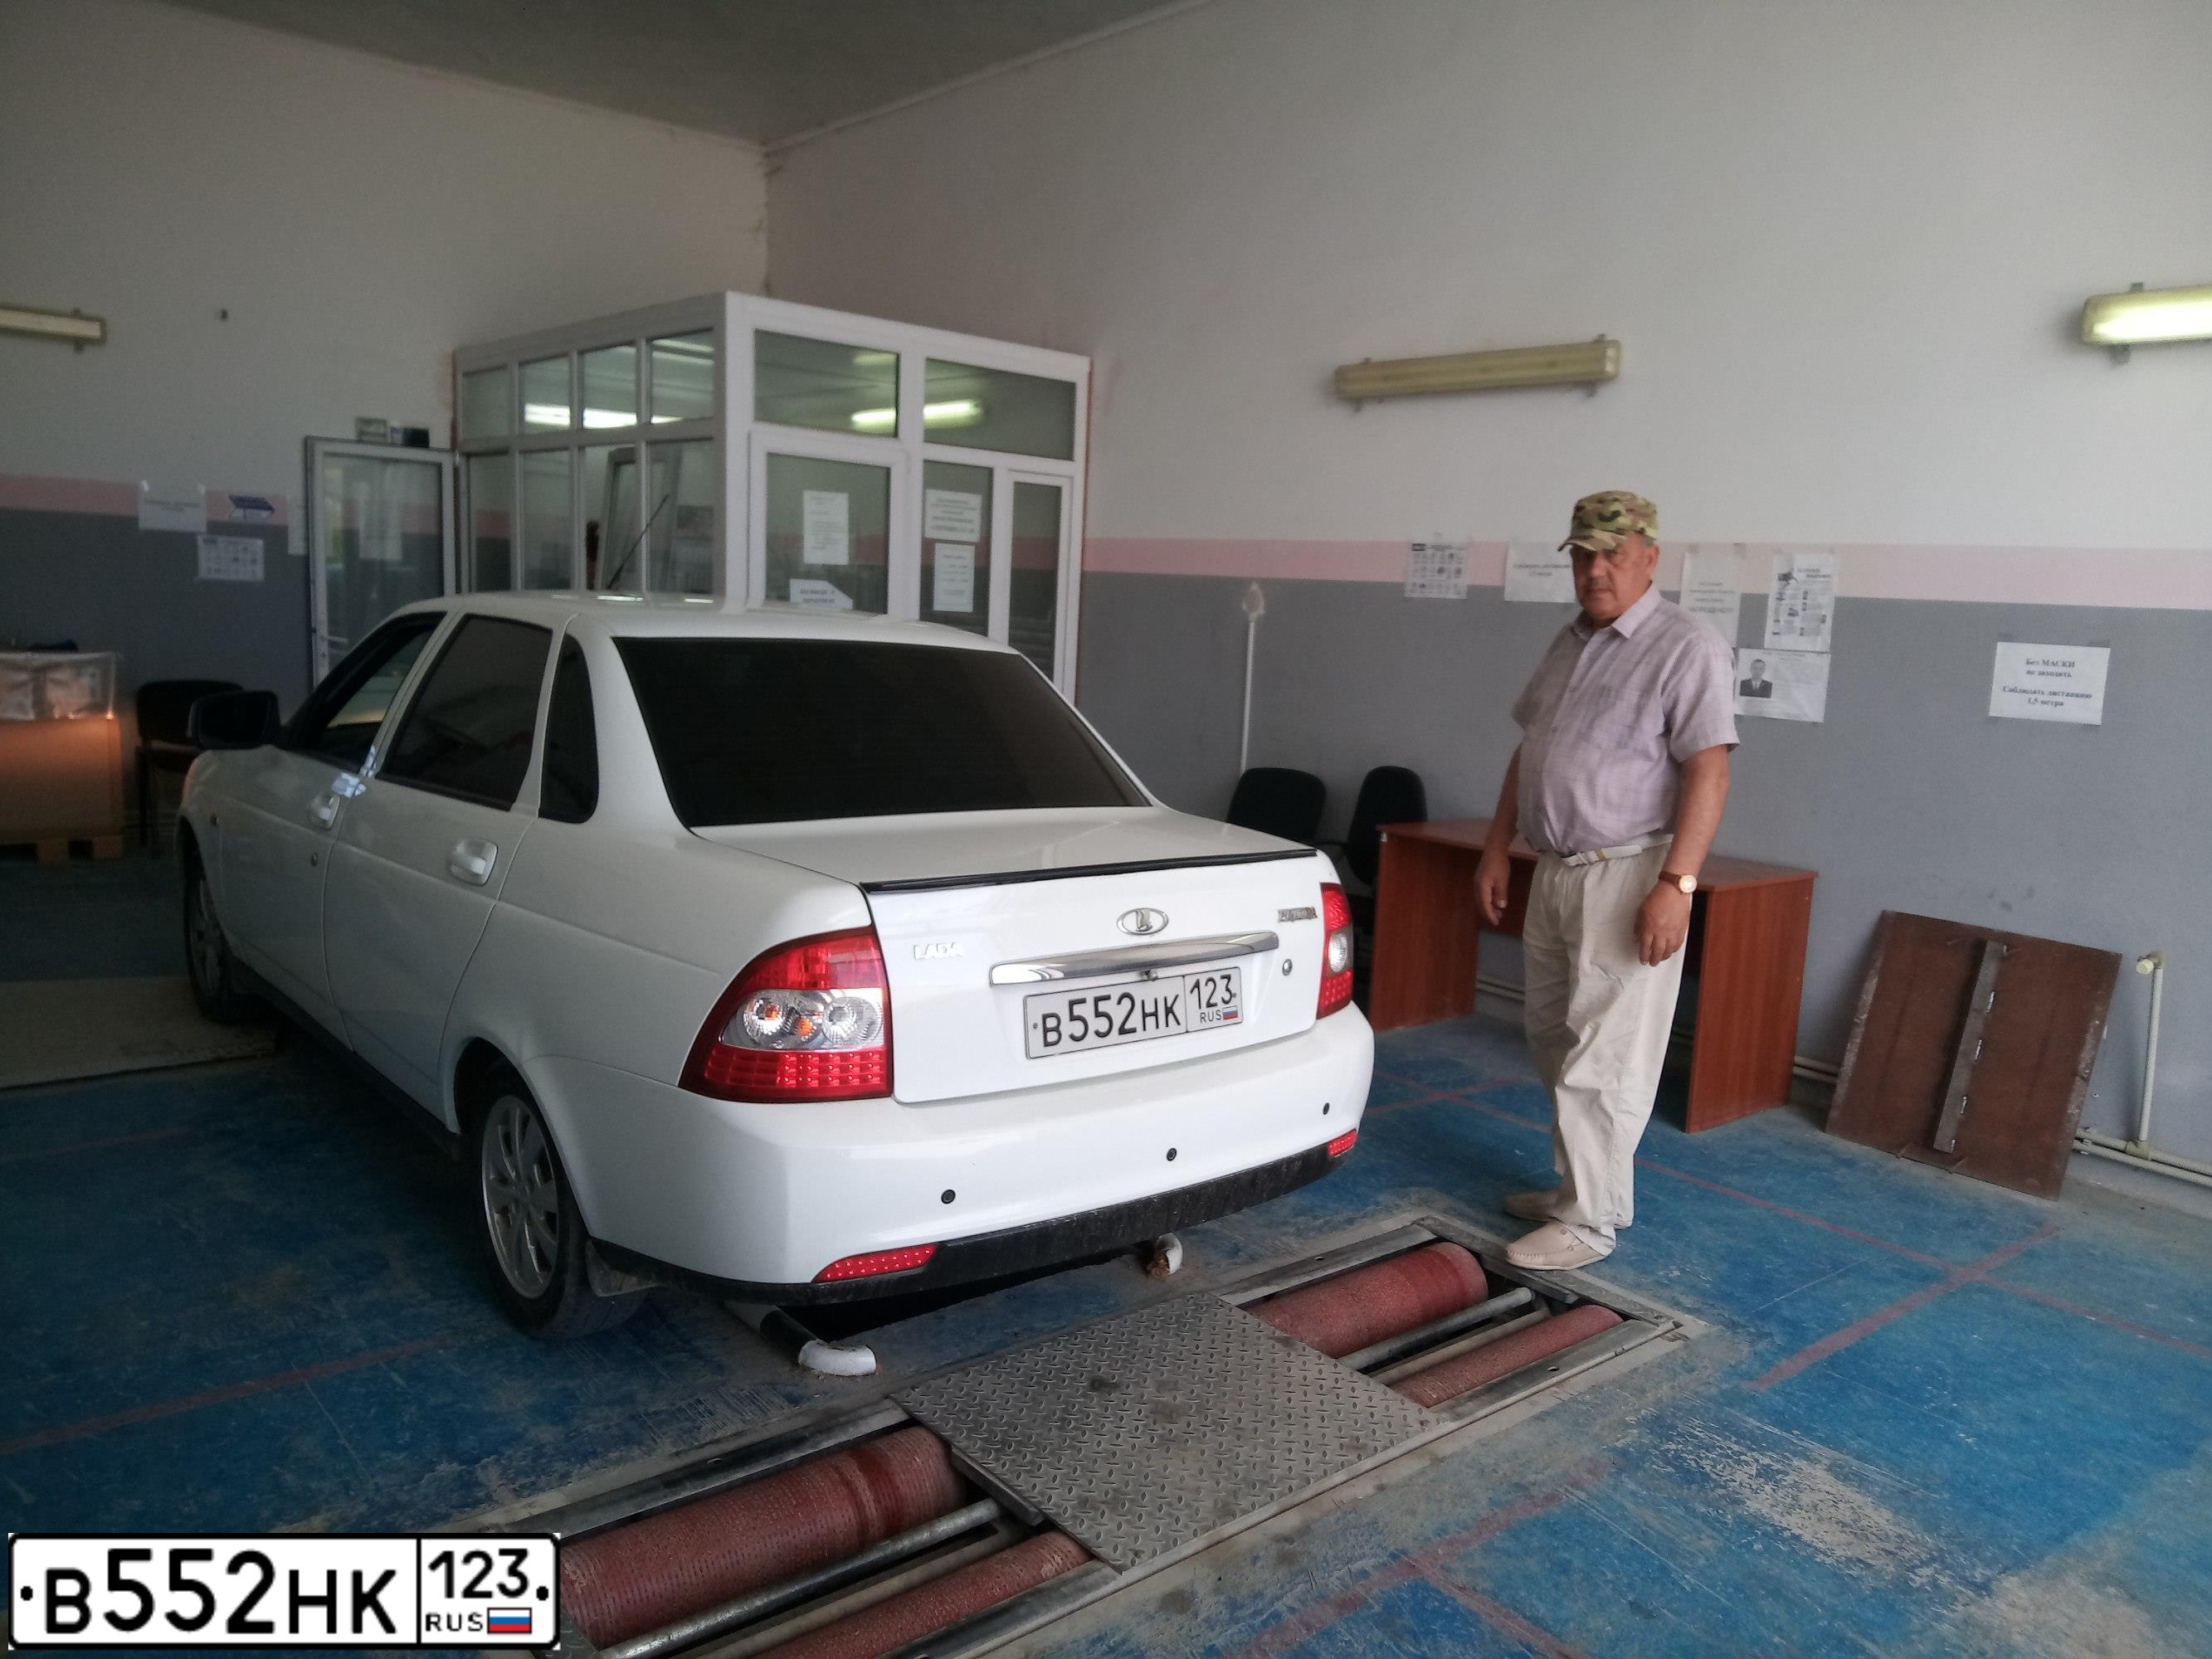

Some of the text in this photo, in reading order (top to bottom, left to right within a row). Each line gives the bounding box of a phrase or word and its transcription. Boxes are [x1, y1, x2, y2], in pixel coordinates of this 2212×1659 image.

[2042, 659, 2075, 669] МАСКИ
[2003, 686, 2045, 695] Соблюдать
[913, 942, 964, 961] LADA
[1190, 974, 1233, 1010] 123
[1200, 1010, 1222, 1024] RUS
